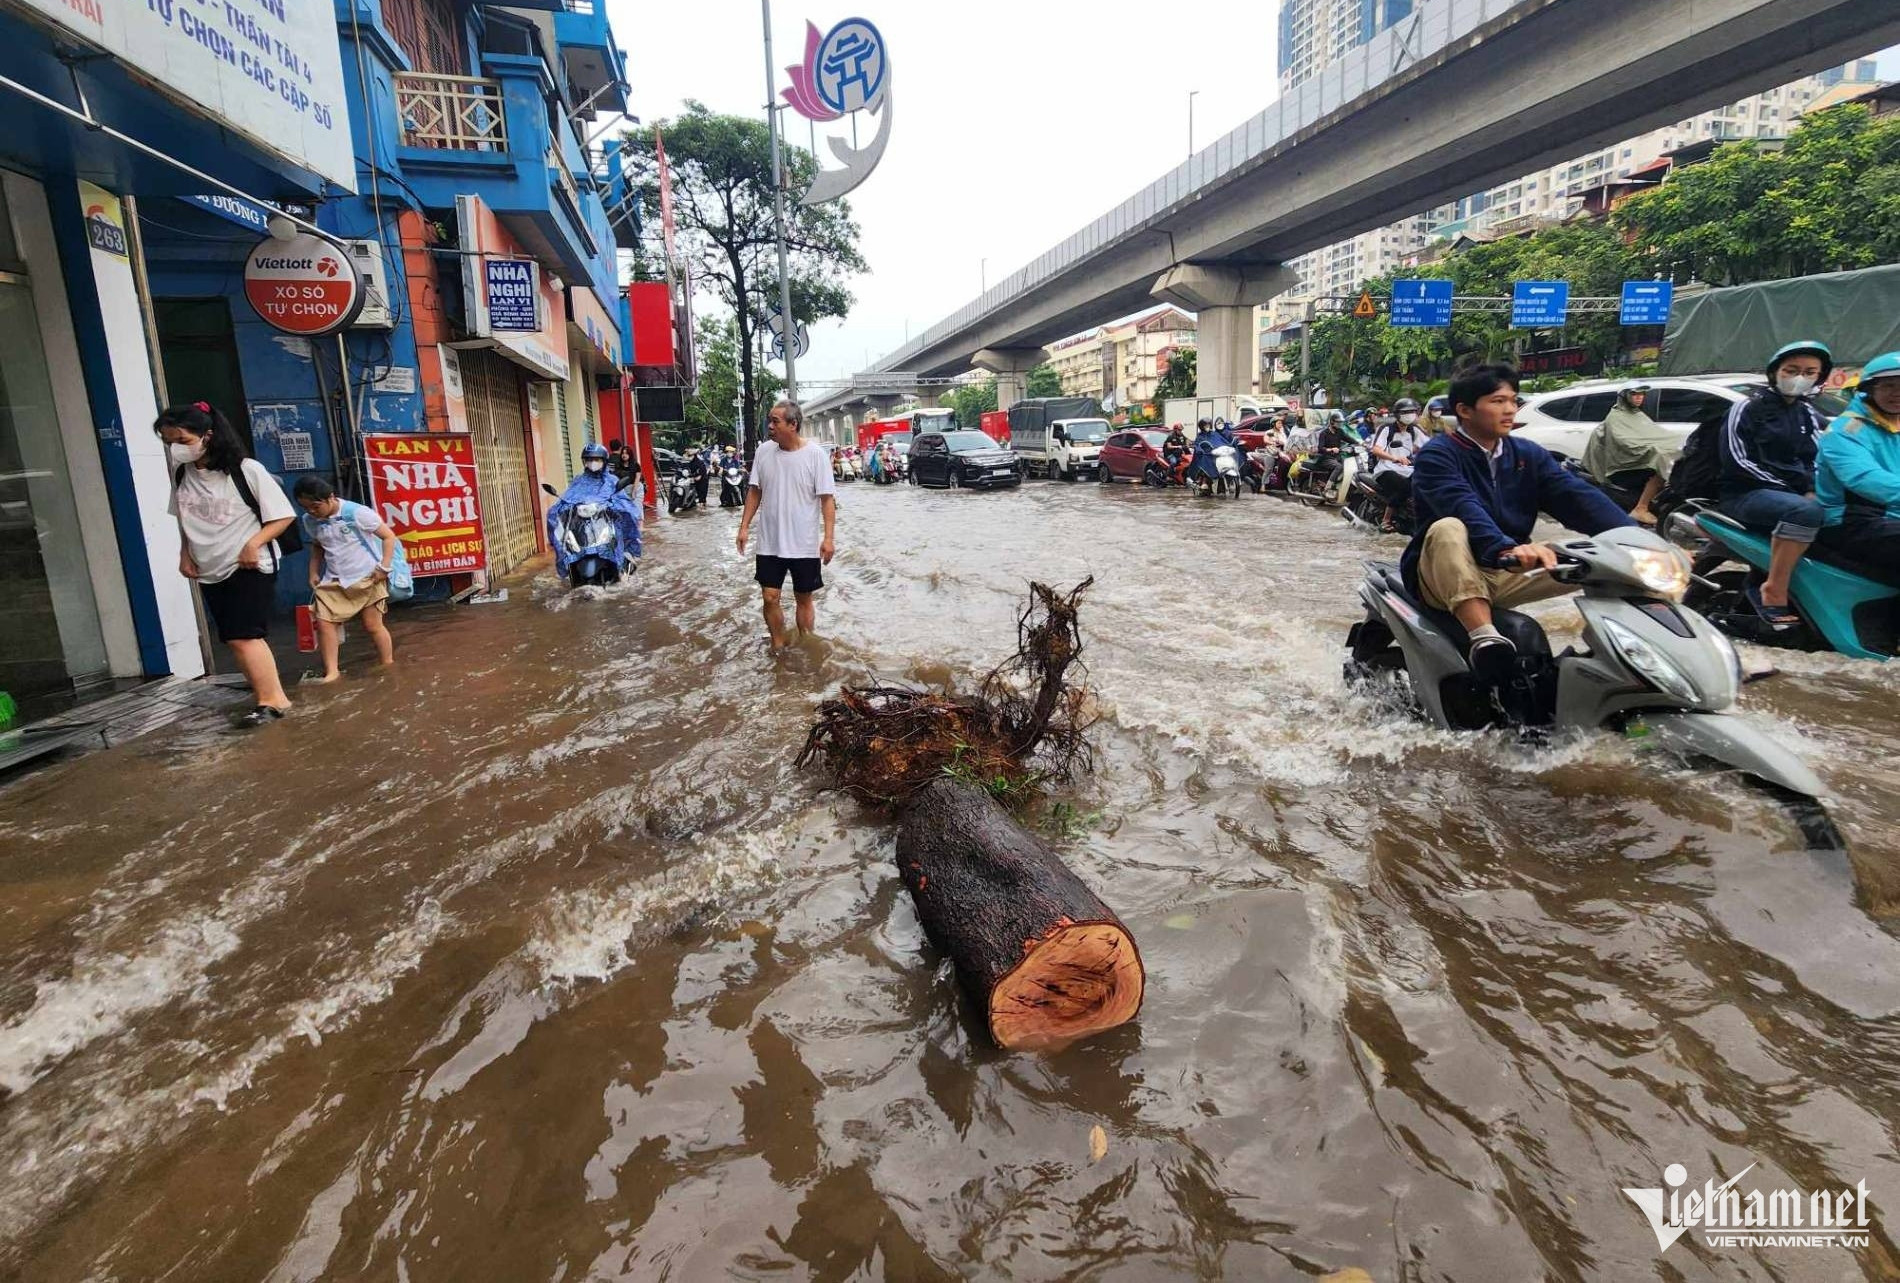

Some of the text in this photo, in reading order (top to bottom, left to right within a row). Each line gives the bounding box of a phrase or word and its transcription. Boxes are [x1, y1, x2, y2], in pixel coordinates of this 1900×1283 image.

[221, 1, 271, 55] THẦN
[274, 40, 299, 75] TÀI
[304, 63, 312, 84] 4
[179, 8, 235, 66] CHỌN
[241, 51, 275, 92] CÁC
[280, 78, 309, 113] CẶP
[313, 102, 332, 130] SỐ
[94, 225, 124, 251] 263
[255, 257, 313, 269] Vietlott
[489, 264, 529, 280] NHÀ
[489, 280, 531, 297] NGHỈ
[492, 297, 530, 305] LAN VI
[292, 303, 338, 317] CHỌN
[376, 440, 464, 455] LAN VI
[382, 455, 468, 491] NHÀ
[382, 486, 479, 527] NGHỈ
[441, 541, 467, 556] LỊCH
[423, 558, 451, 571] BÌNH
